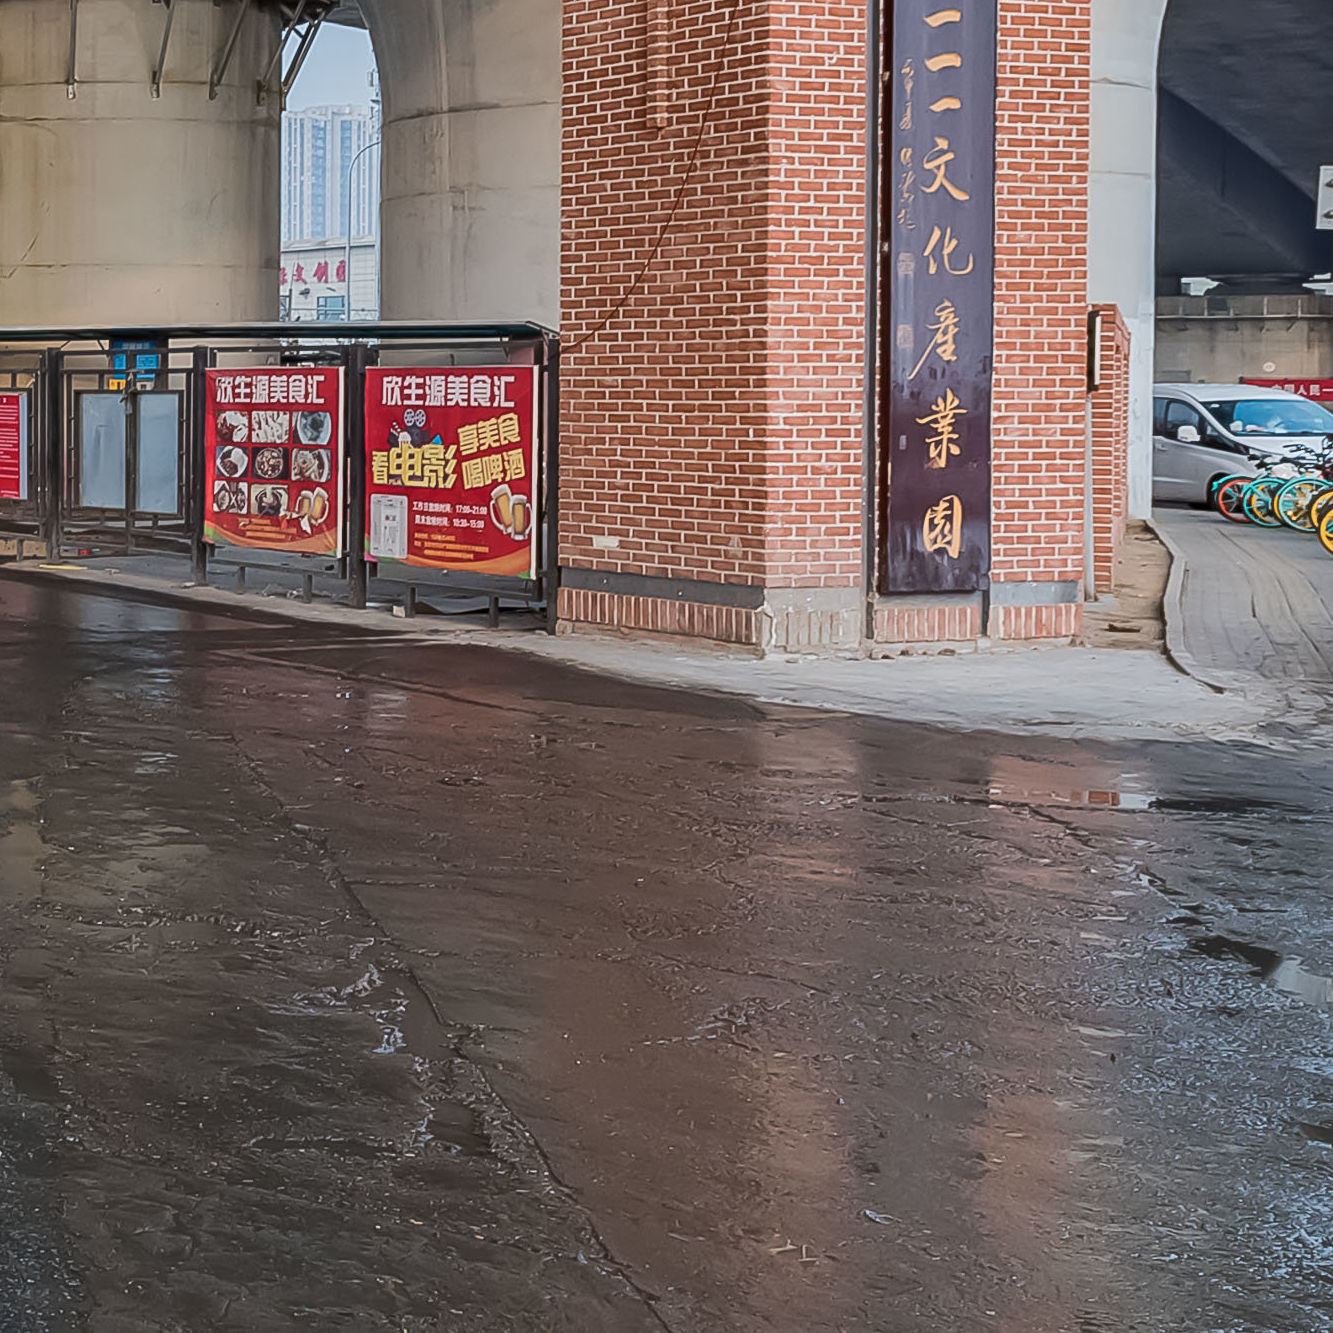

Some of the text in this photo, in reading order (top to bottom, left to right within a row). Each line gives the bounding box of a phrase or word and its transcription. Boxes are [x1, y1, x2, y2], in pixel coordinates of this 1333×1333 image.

[216, 375, 325, 404] 欣生源美食汇
[382, 374, 515, 408] 欣生源美食汇
[457, 412, 521, 456] 享美食
[372, 442, 458, 489] 看电影
[461, 448, 526, 490] 喝啤酒
